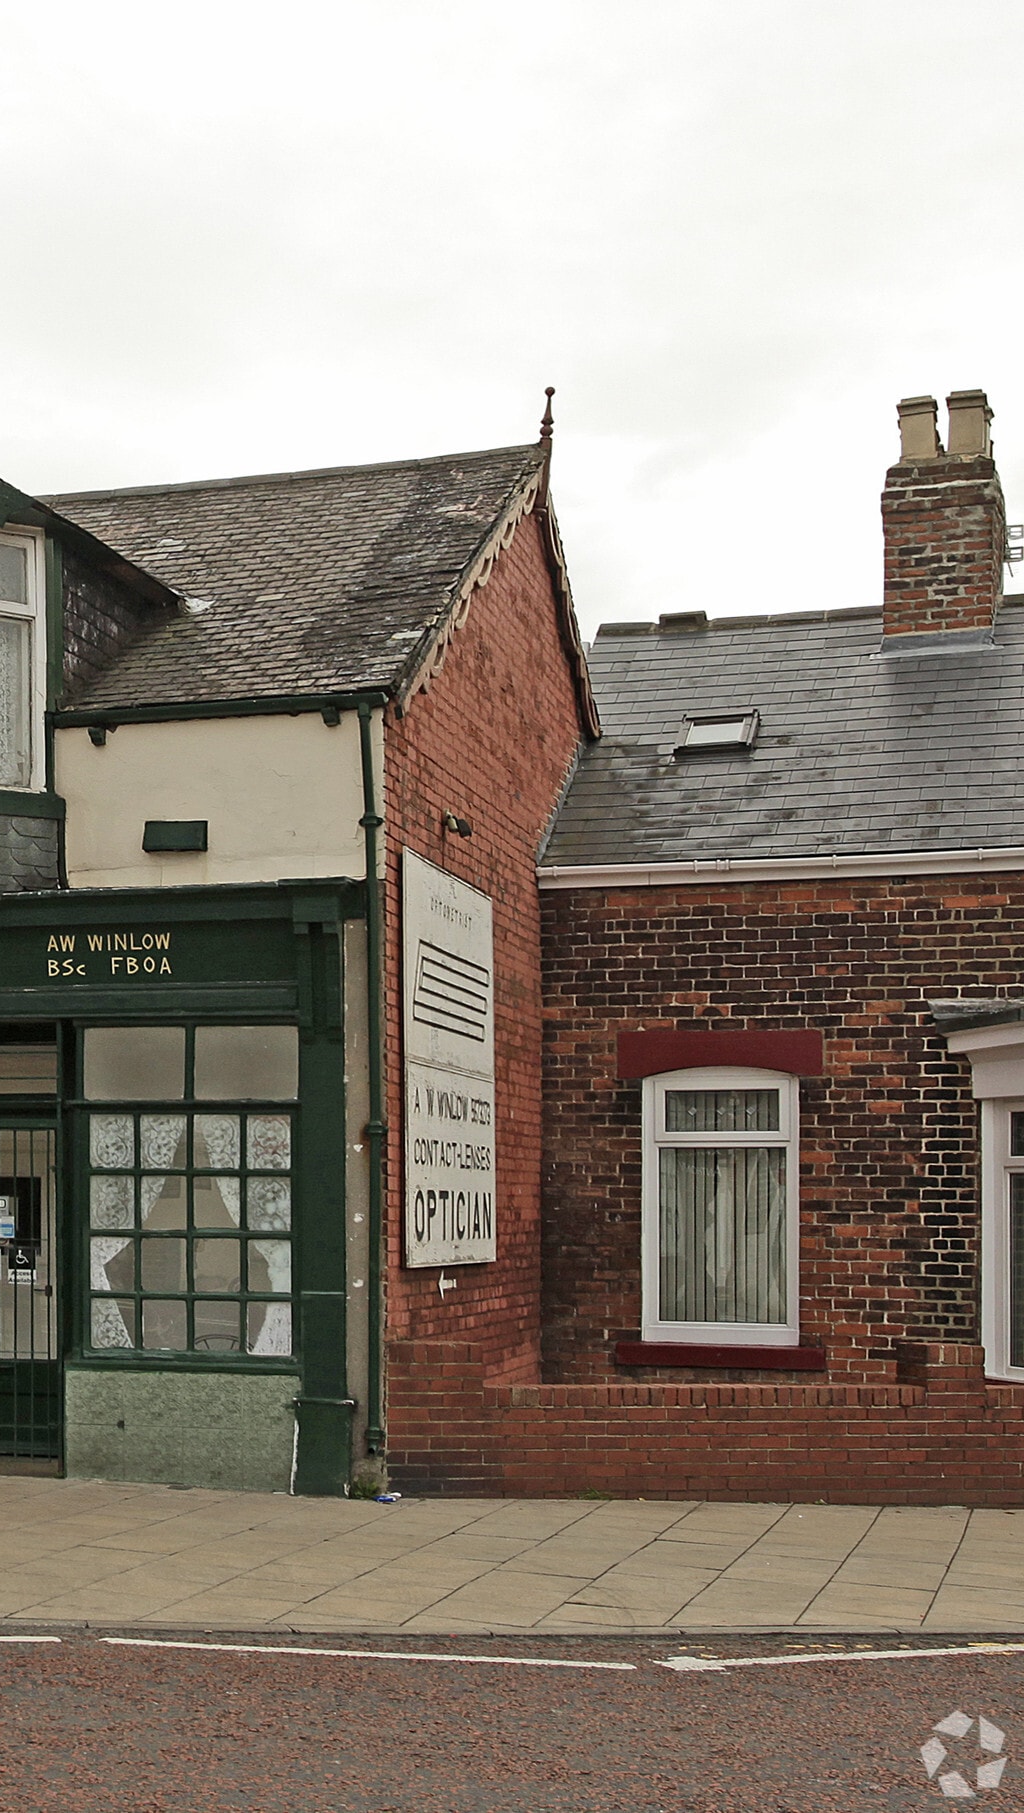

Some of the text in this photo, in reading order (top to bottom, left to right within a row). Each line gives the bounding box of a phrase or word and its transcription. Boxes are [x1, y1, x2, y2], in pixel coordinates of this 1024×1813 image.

[47, 932, 171, 952] AW WINLOW
[47, 956, 173, 977] BSc FBOA
[414, 1087, 420, 1113] A
[426, 1088, 434, 1117] W
[415, 1189, 491, 1242] OPTICIAN
